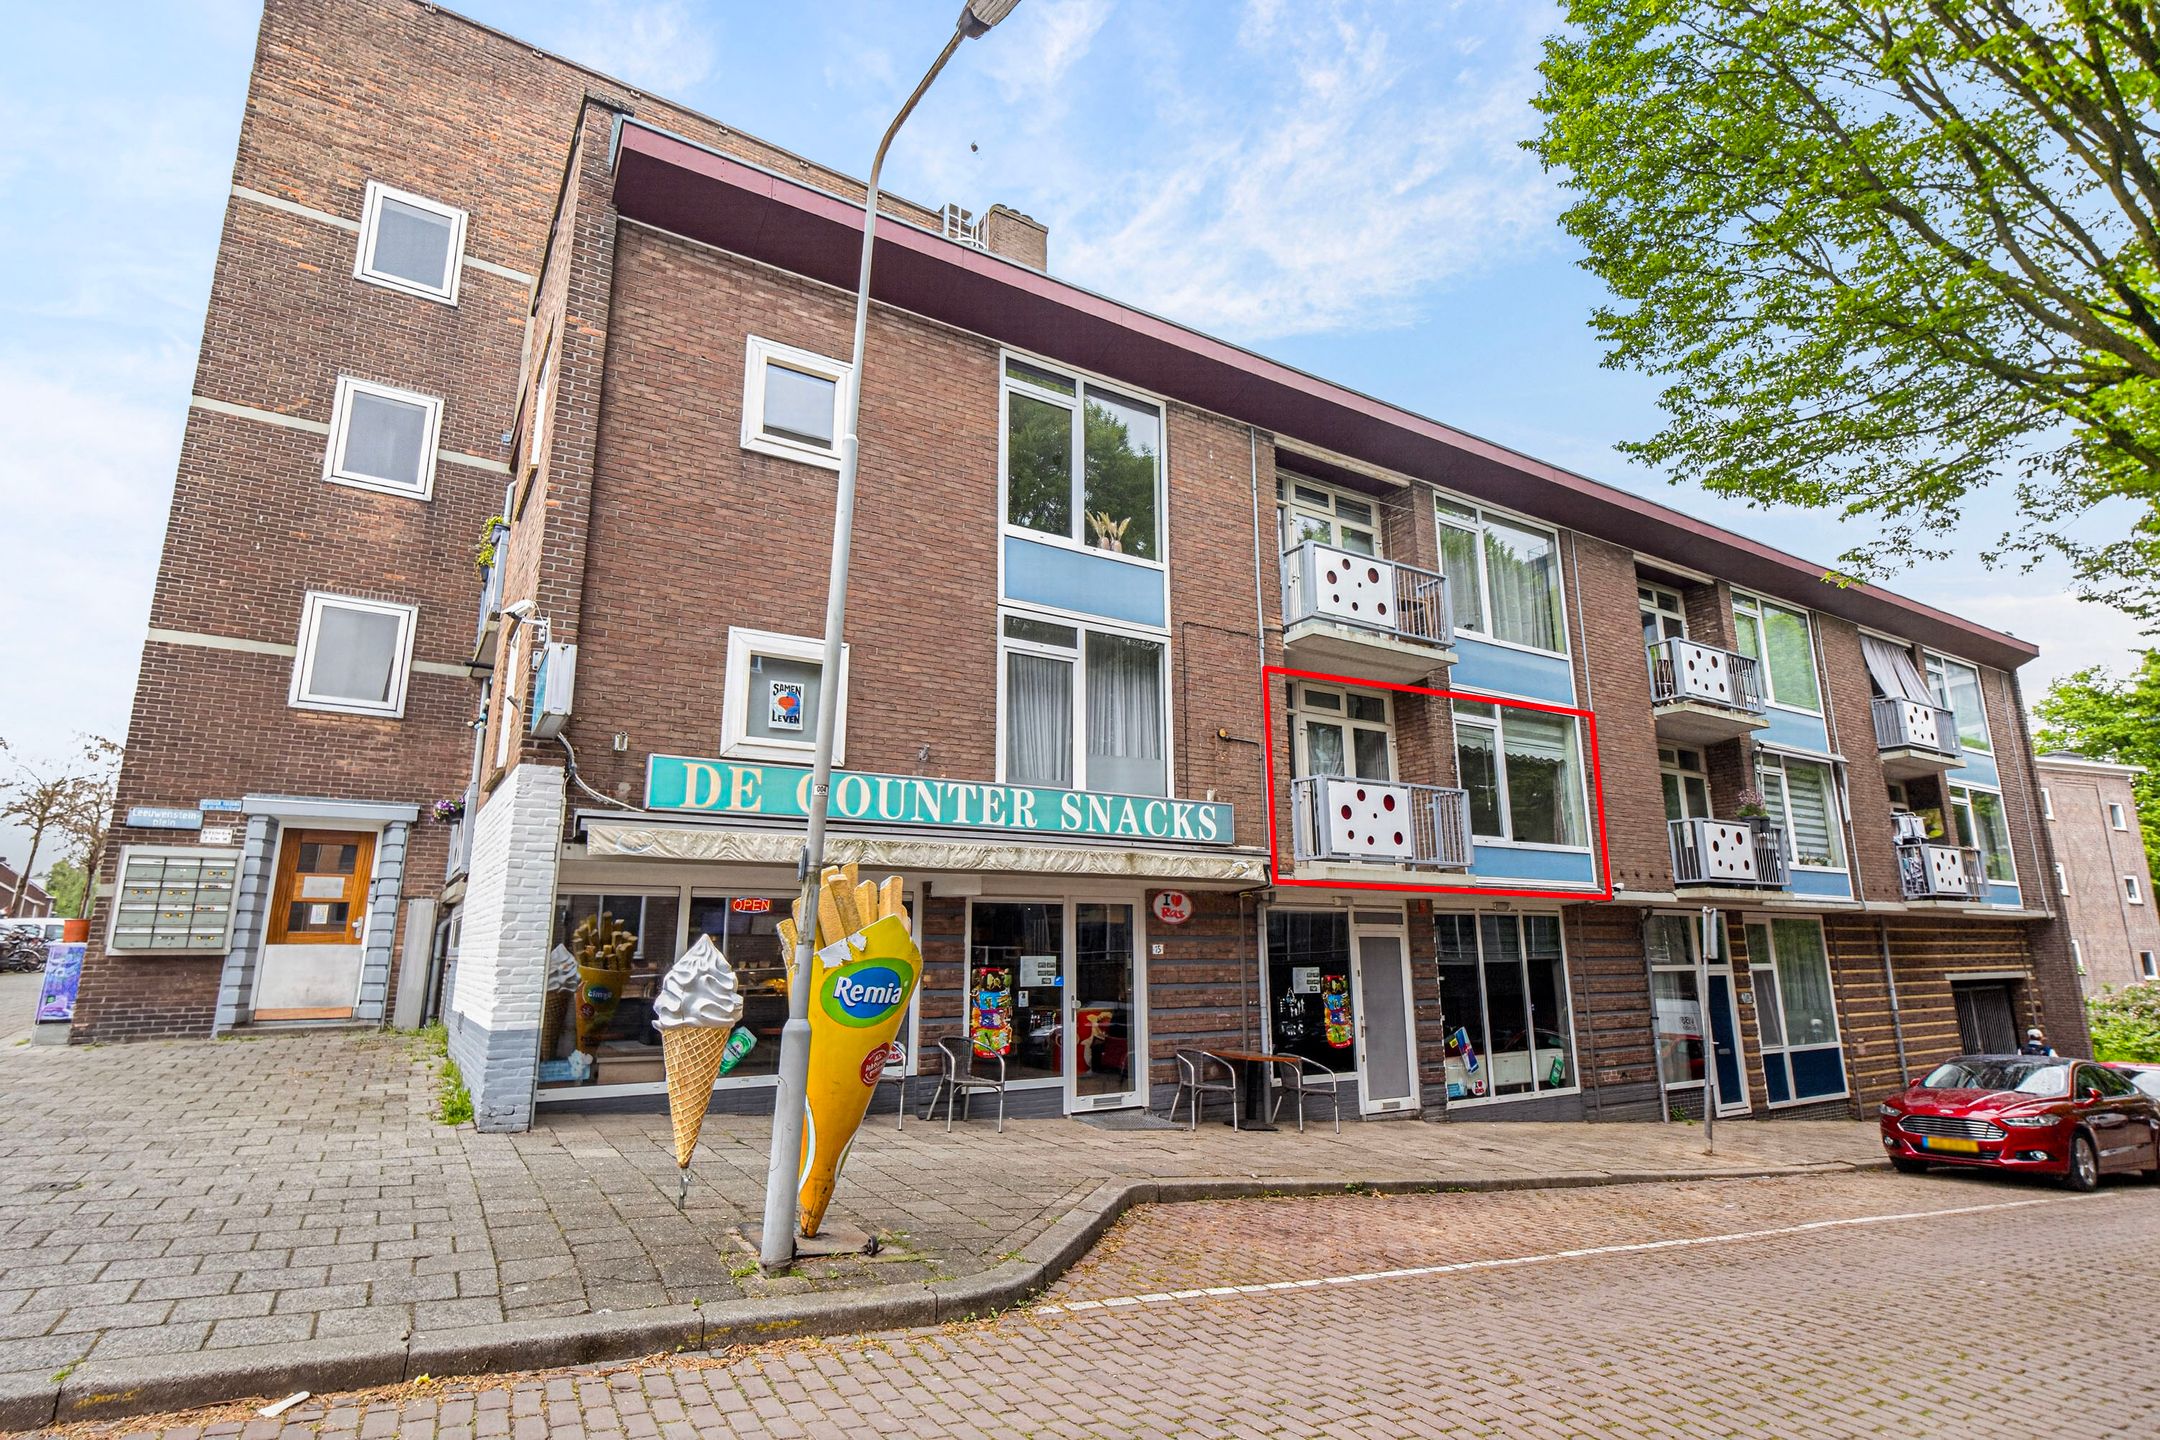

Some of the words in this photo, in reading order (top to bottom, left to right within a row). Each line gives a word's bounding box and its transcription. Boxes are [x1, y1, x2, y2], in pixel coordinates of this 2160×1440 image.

[773, 684, 801, 698] SAMEN
[772, 709, 800, 724] LEVEN
[679, 762, 763, 812] DE
[1060, 793, 1217, 841] SNACKS
[152, 819, 176, 828] plein
[733, 900, 770, 911] OPEN
[1163, 894, 1170, 905] I
[833, 976, 903, 1007] Remia
